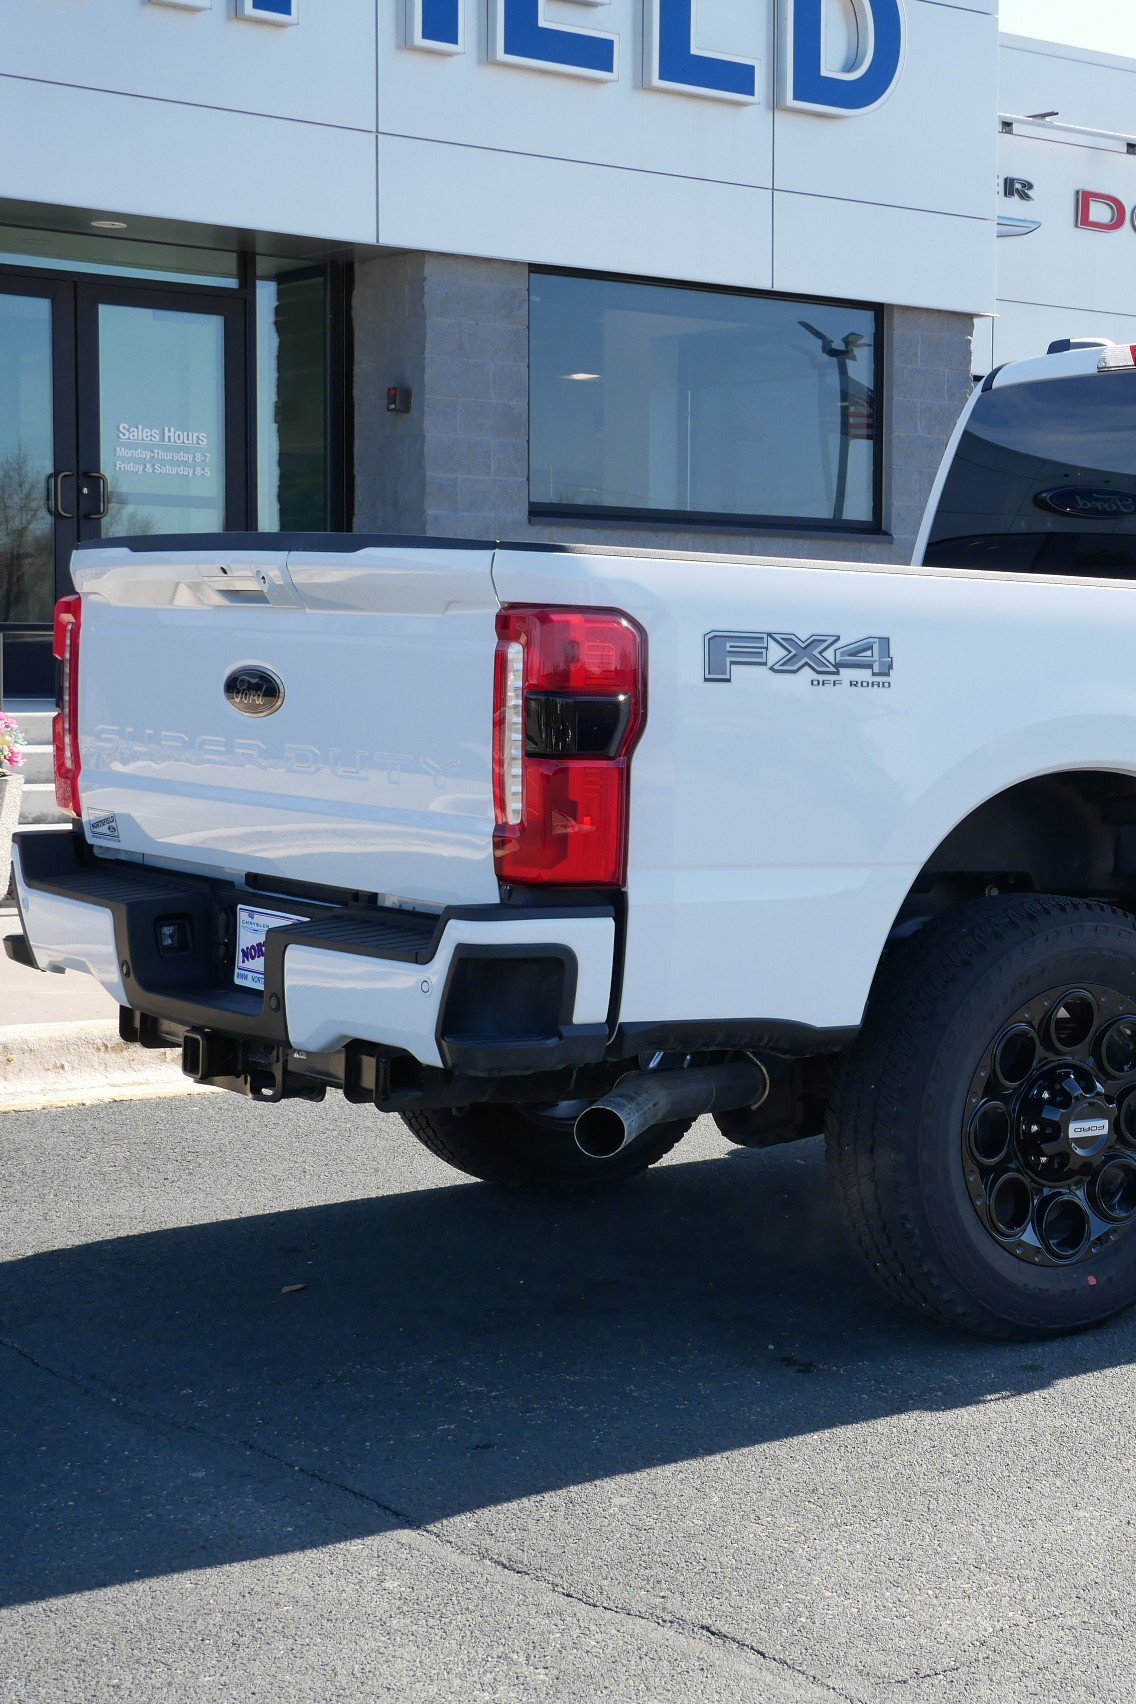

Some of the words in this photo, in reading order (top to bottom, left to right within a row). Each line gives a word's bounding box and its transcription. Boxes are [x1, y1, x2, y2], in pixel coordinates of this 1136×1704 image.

[997, 175, 1035, 201] R
[119, 423, 160, 442] Sales
[164, 426, 208, 446] Hours
[116, 447, 193, 462] Monday-Thursday
[195, 452, 211, 463] 8-7
[116, 461, 142, 473] Friday
[145, 463, 153, 473] &
[154, 464, 194, 477] Saturday
[195, 467, 211, 477] 8-5
[704, 630, 894, 683] FX4
[233, 675, 267, 705] Ford
[810, 678, 843, 688] OFF
[849, 679, 892, 689] ROAD
[95, 725, 269, 770] SUPER
[284, 743, 462, 790] DUTY
[240, 940, 265, 963] NOR
[1074, 1124, 1105, 1133] FORD
